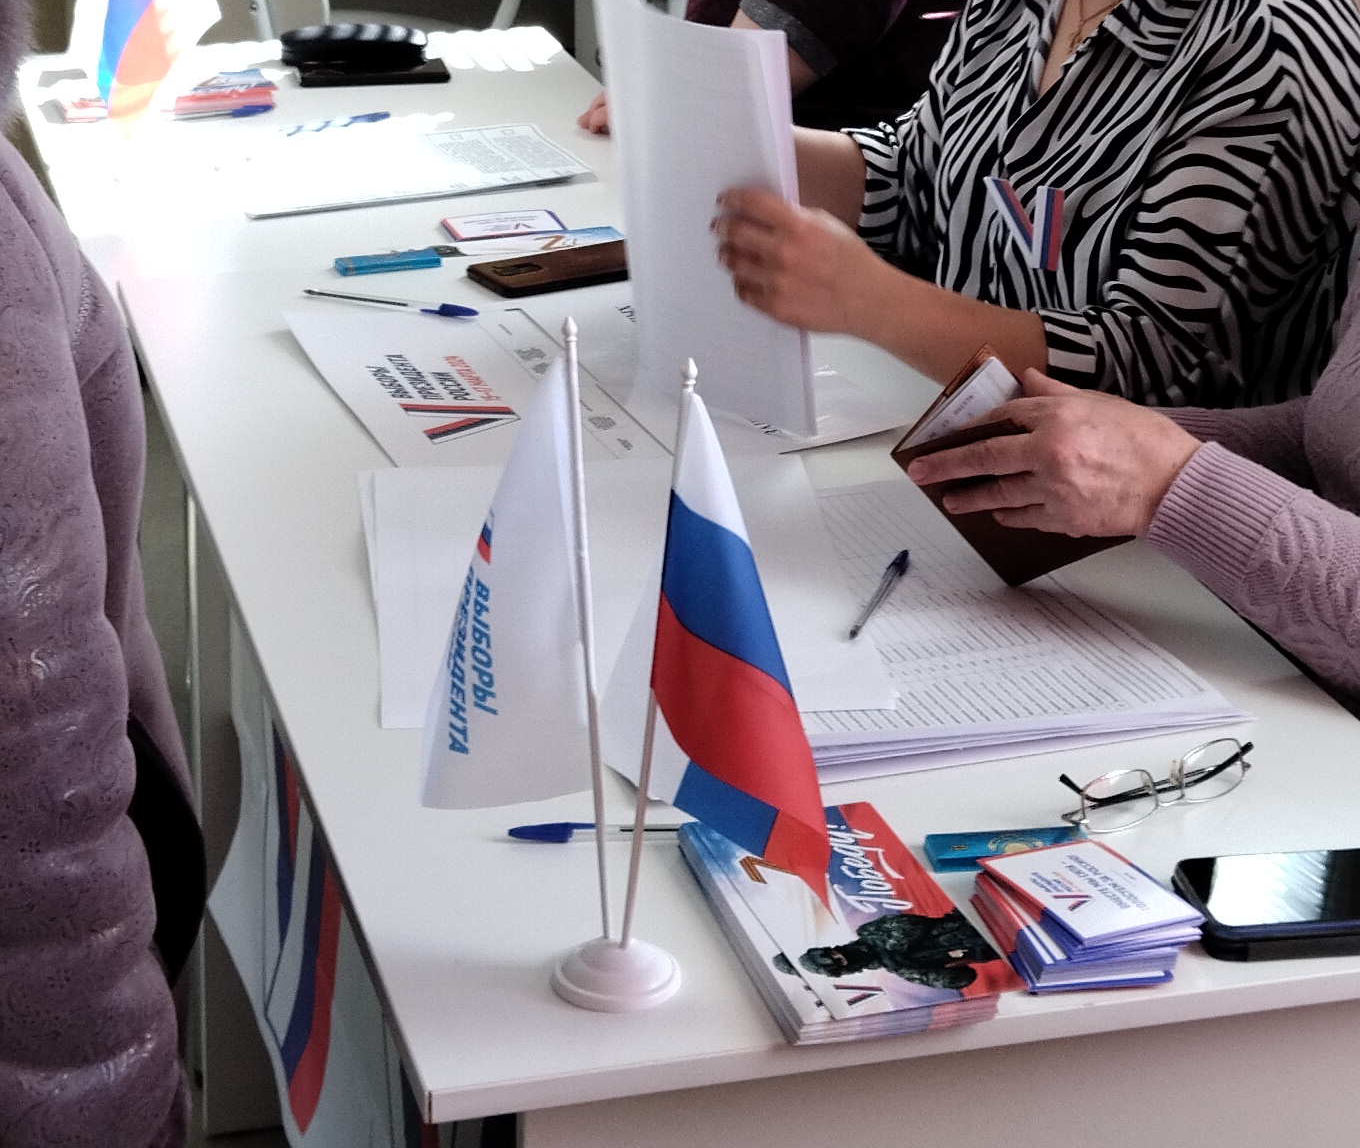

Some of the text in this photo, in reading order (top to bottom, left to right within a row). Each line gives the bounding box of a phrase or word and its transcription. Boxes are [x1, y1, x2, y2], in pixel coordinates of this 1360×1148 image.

[366, 364, 414, 400] ВЫБОРЫ
[384, 354, 445, 401] ПРЕЗИДЕНТА
[429, 371, 476, 401] РОССИИ
[471, 578, 499, 716] ВЫБОРЫ
